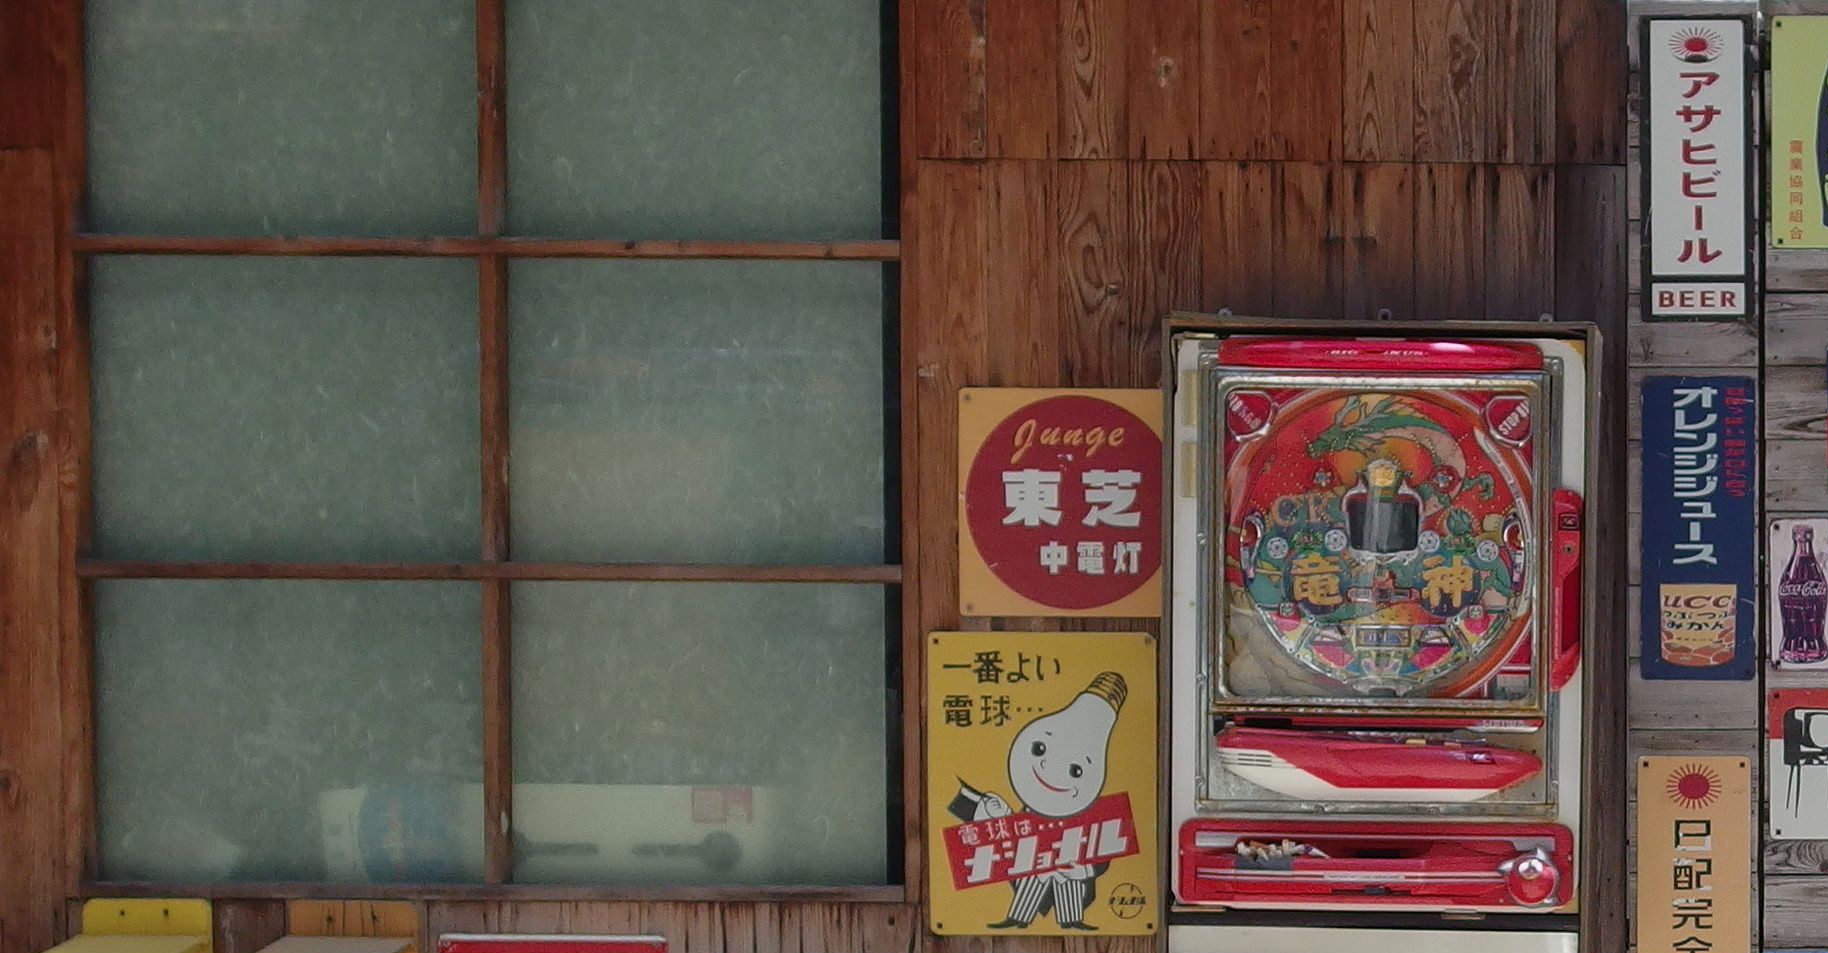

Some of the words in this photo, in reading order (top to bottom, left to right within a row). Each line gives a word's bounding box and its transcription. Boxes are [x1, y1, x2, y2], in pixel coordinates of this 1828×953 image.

[1675, 71, 1723, 265] アサヒビール
[1658, 289, 1737, 309] BEER
[1012, 418, 1126, 466] Junge
[1001, 469, 1143, 528] 東芝
[1672, 386, 1719, 565] オレンジジュース
[1039, 540, 1142, 576] 中電灯
[943, 650, 1061, 685] 一番よい
[964, 818, 1128, 884] ナショナル
